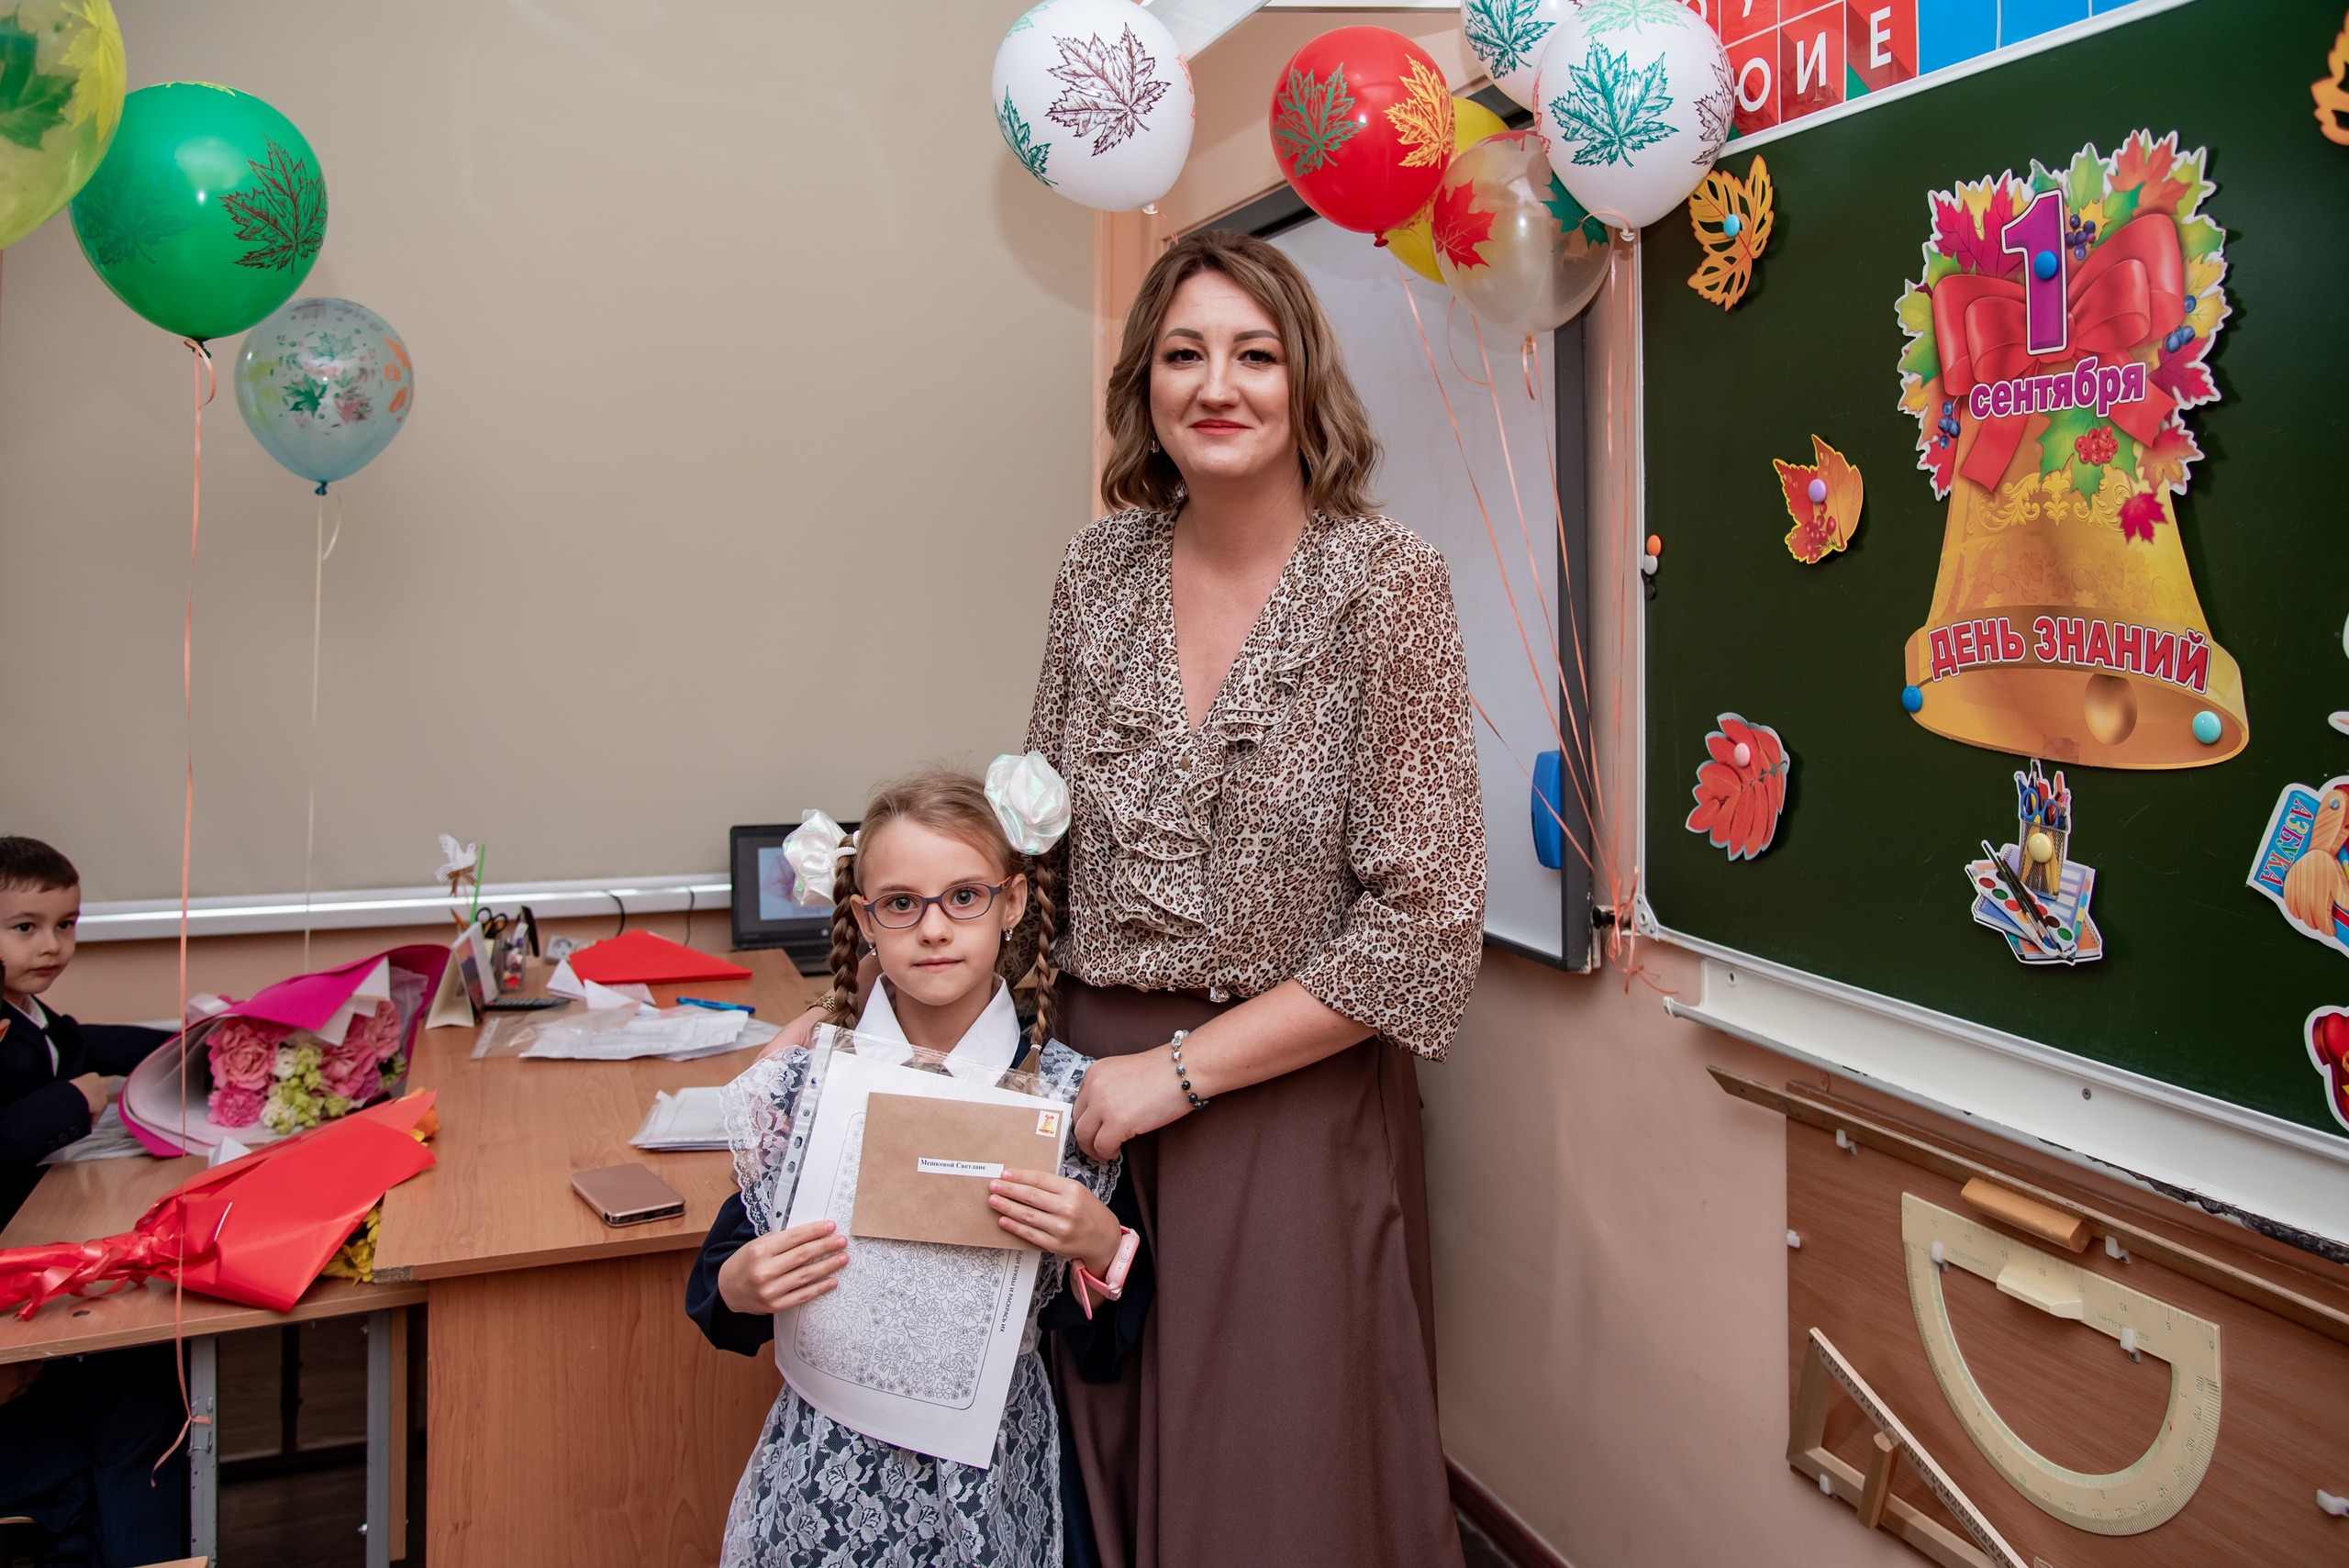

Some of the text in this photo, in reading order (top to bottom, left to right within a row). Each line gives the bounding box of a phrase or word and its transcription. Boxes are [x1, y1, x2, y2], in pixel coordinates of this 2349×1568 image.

[2001, 189, 2067, 355] 1
[1970, 356, 2146, 418] сентября
[1928, 615, 2211, 695] ДЕНЬ ЗНАНИЙ
[2260, 798, 2314, 887] АЗБУКА
[920, 1159, 986, 1171] Мешковой Светлане
[1010, 1265, 1020, 1286] БУКВЫ
[999, 1323, 1006, 1333] ИХ
[1002, 1293, 1014, 1323] РАСКРАСЬ
